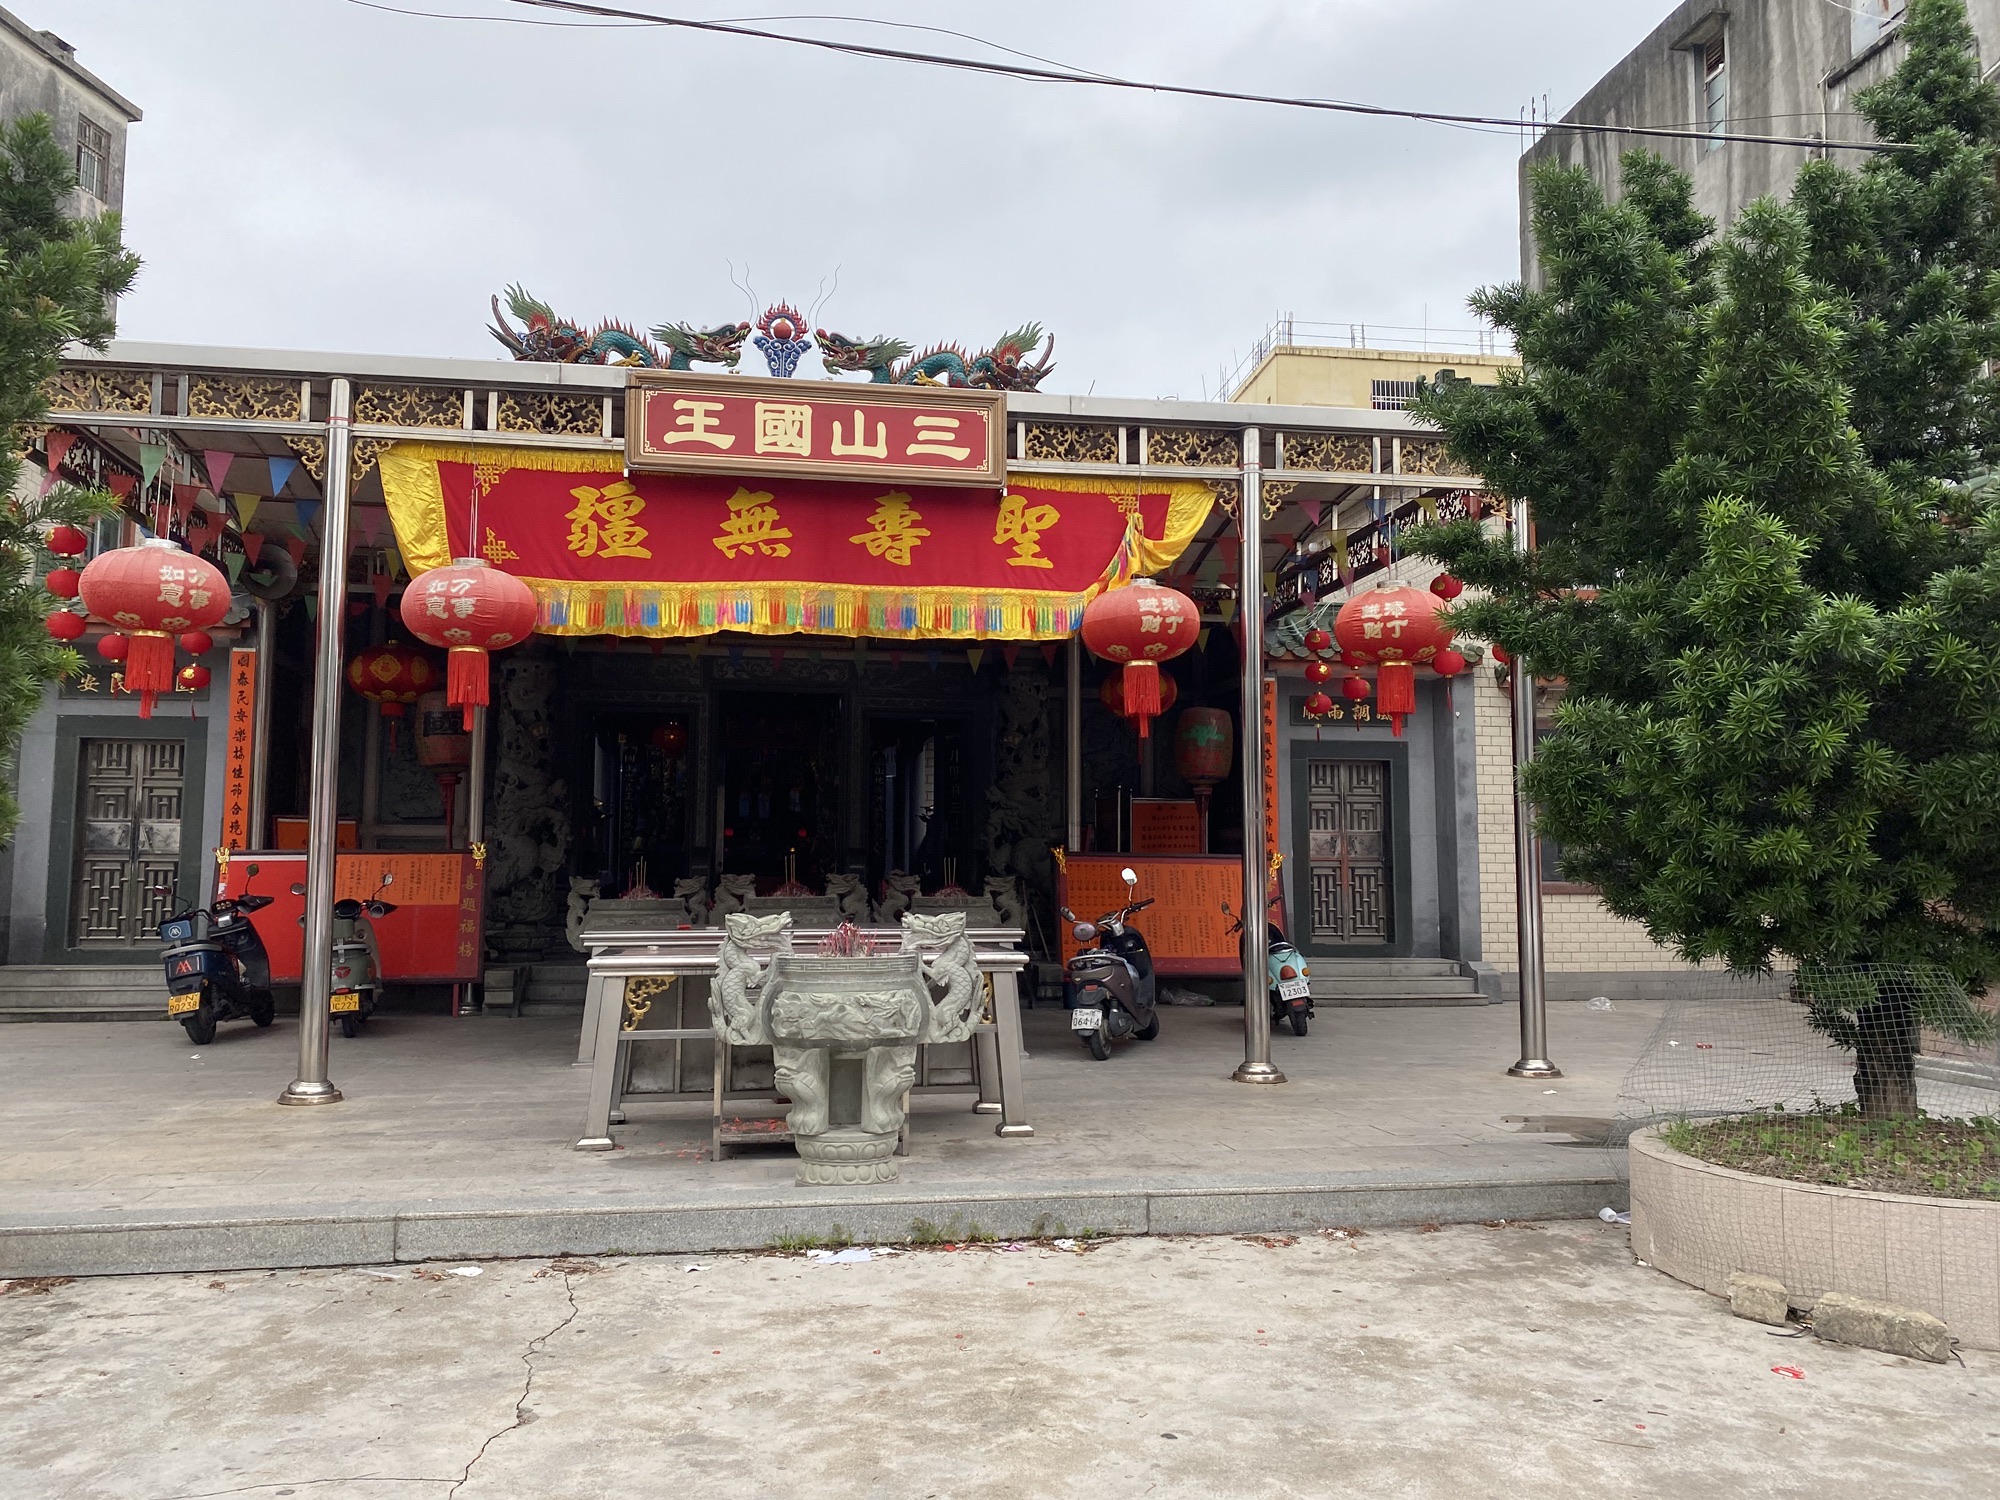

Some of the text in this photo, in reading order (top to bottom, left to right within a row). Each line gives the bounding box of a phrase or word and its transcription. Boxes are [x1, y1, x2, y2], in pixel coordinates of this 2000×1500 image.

[663, 399, 971, 461] 三山國王
[1282, 986, 1308, 998] 12303
